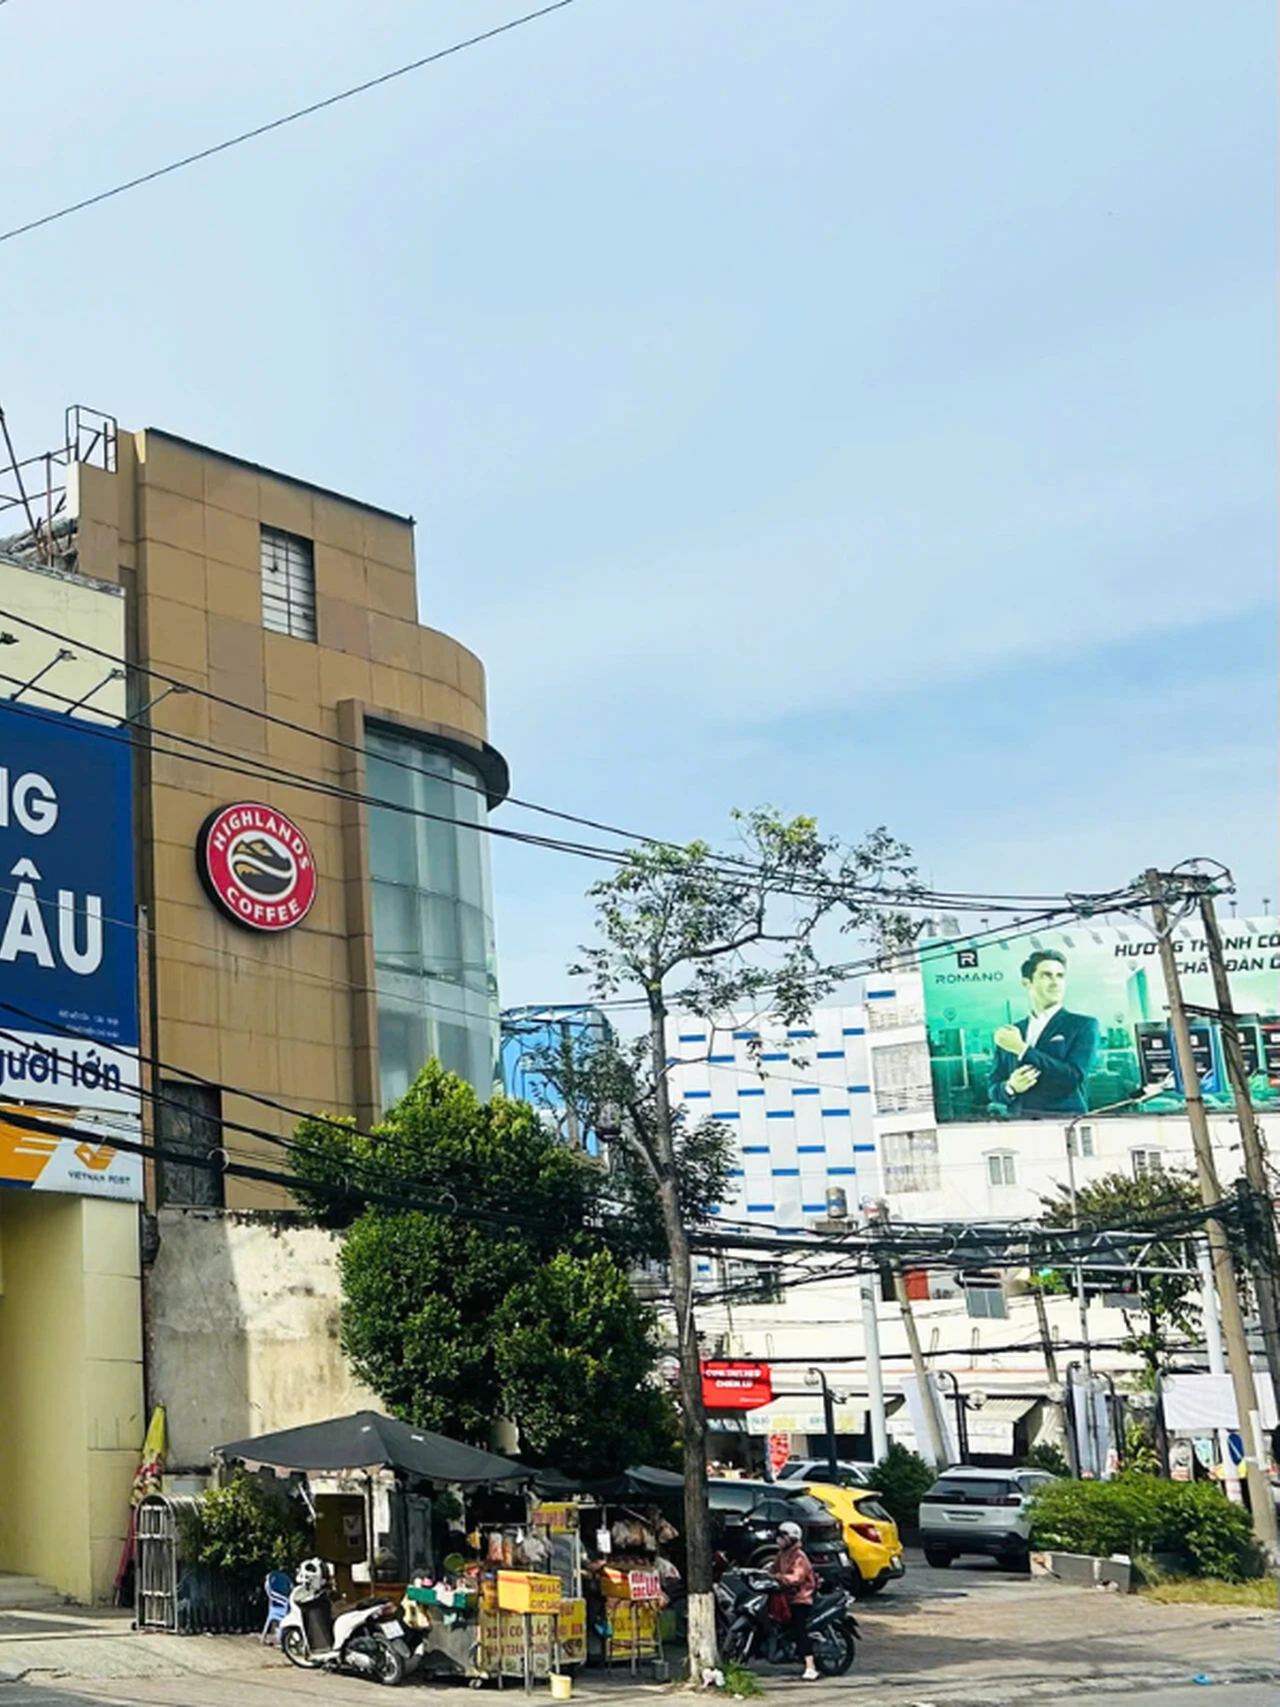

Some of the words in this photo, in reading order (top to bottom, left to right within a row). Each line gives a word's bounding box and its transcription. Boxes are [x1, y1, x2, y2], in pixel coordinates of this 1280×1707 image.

[214, 811, 310, 870] HIGHLANDS
[226, 886, 300, 922] COFFEE
[1115, 940, 1184, 957] HƯƠG
[1190, 936, 1253, 953] THNH
[935, 970, 1004, 984] ROMANO
[68, 1170, 105, 1181] VIETNAM
